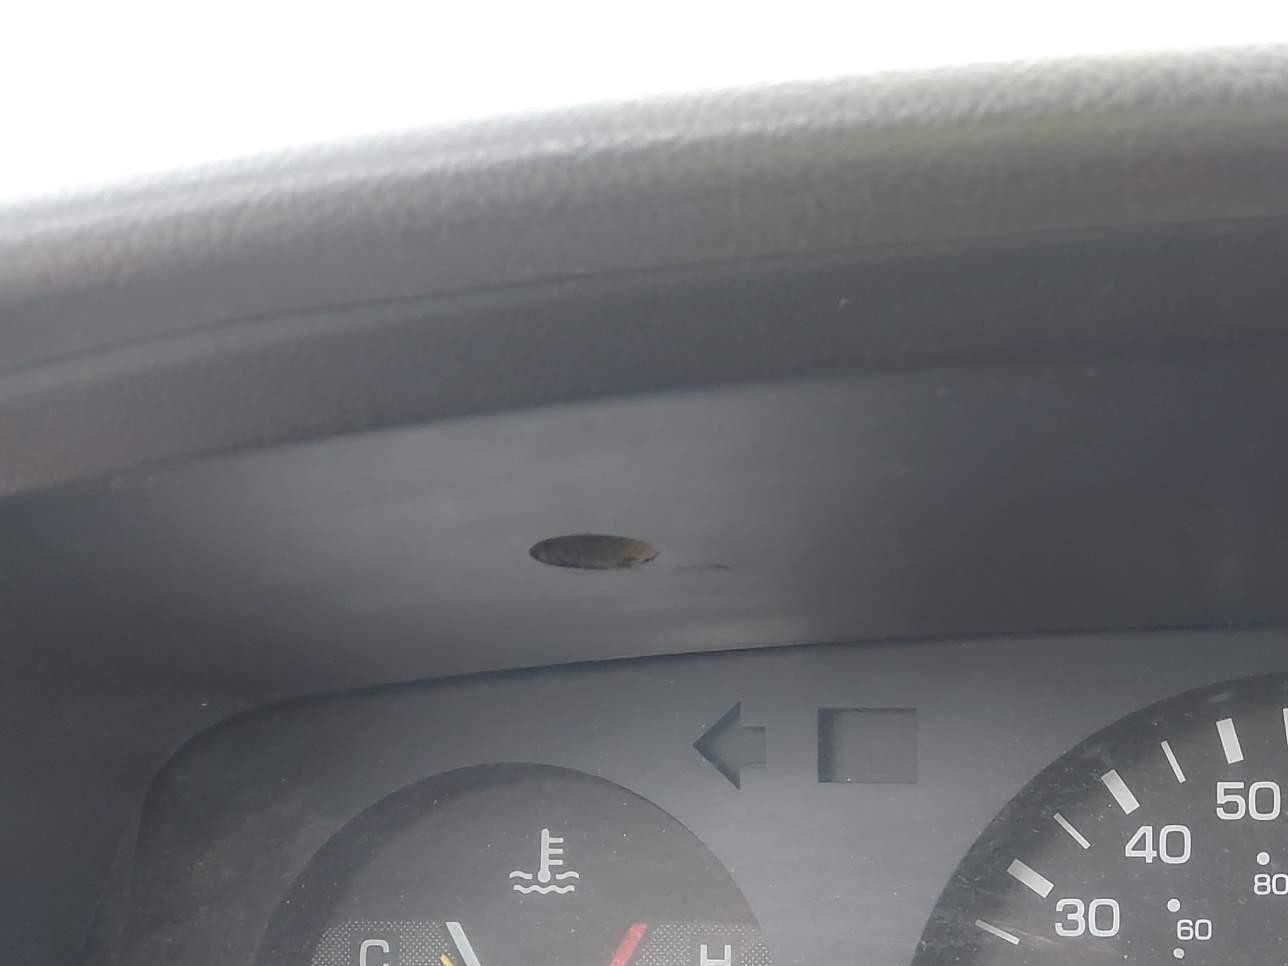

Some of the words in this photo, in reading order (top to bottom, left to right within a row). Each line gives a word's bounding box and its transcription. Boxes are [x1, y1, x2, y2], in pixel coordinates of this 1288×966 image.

[1215, 781, 1281, 821] 50
[1124, 825, 1192, 864] 40
[1054, 898, 1120, 938] 30
[1176, 919, 1212, 941] 60
